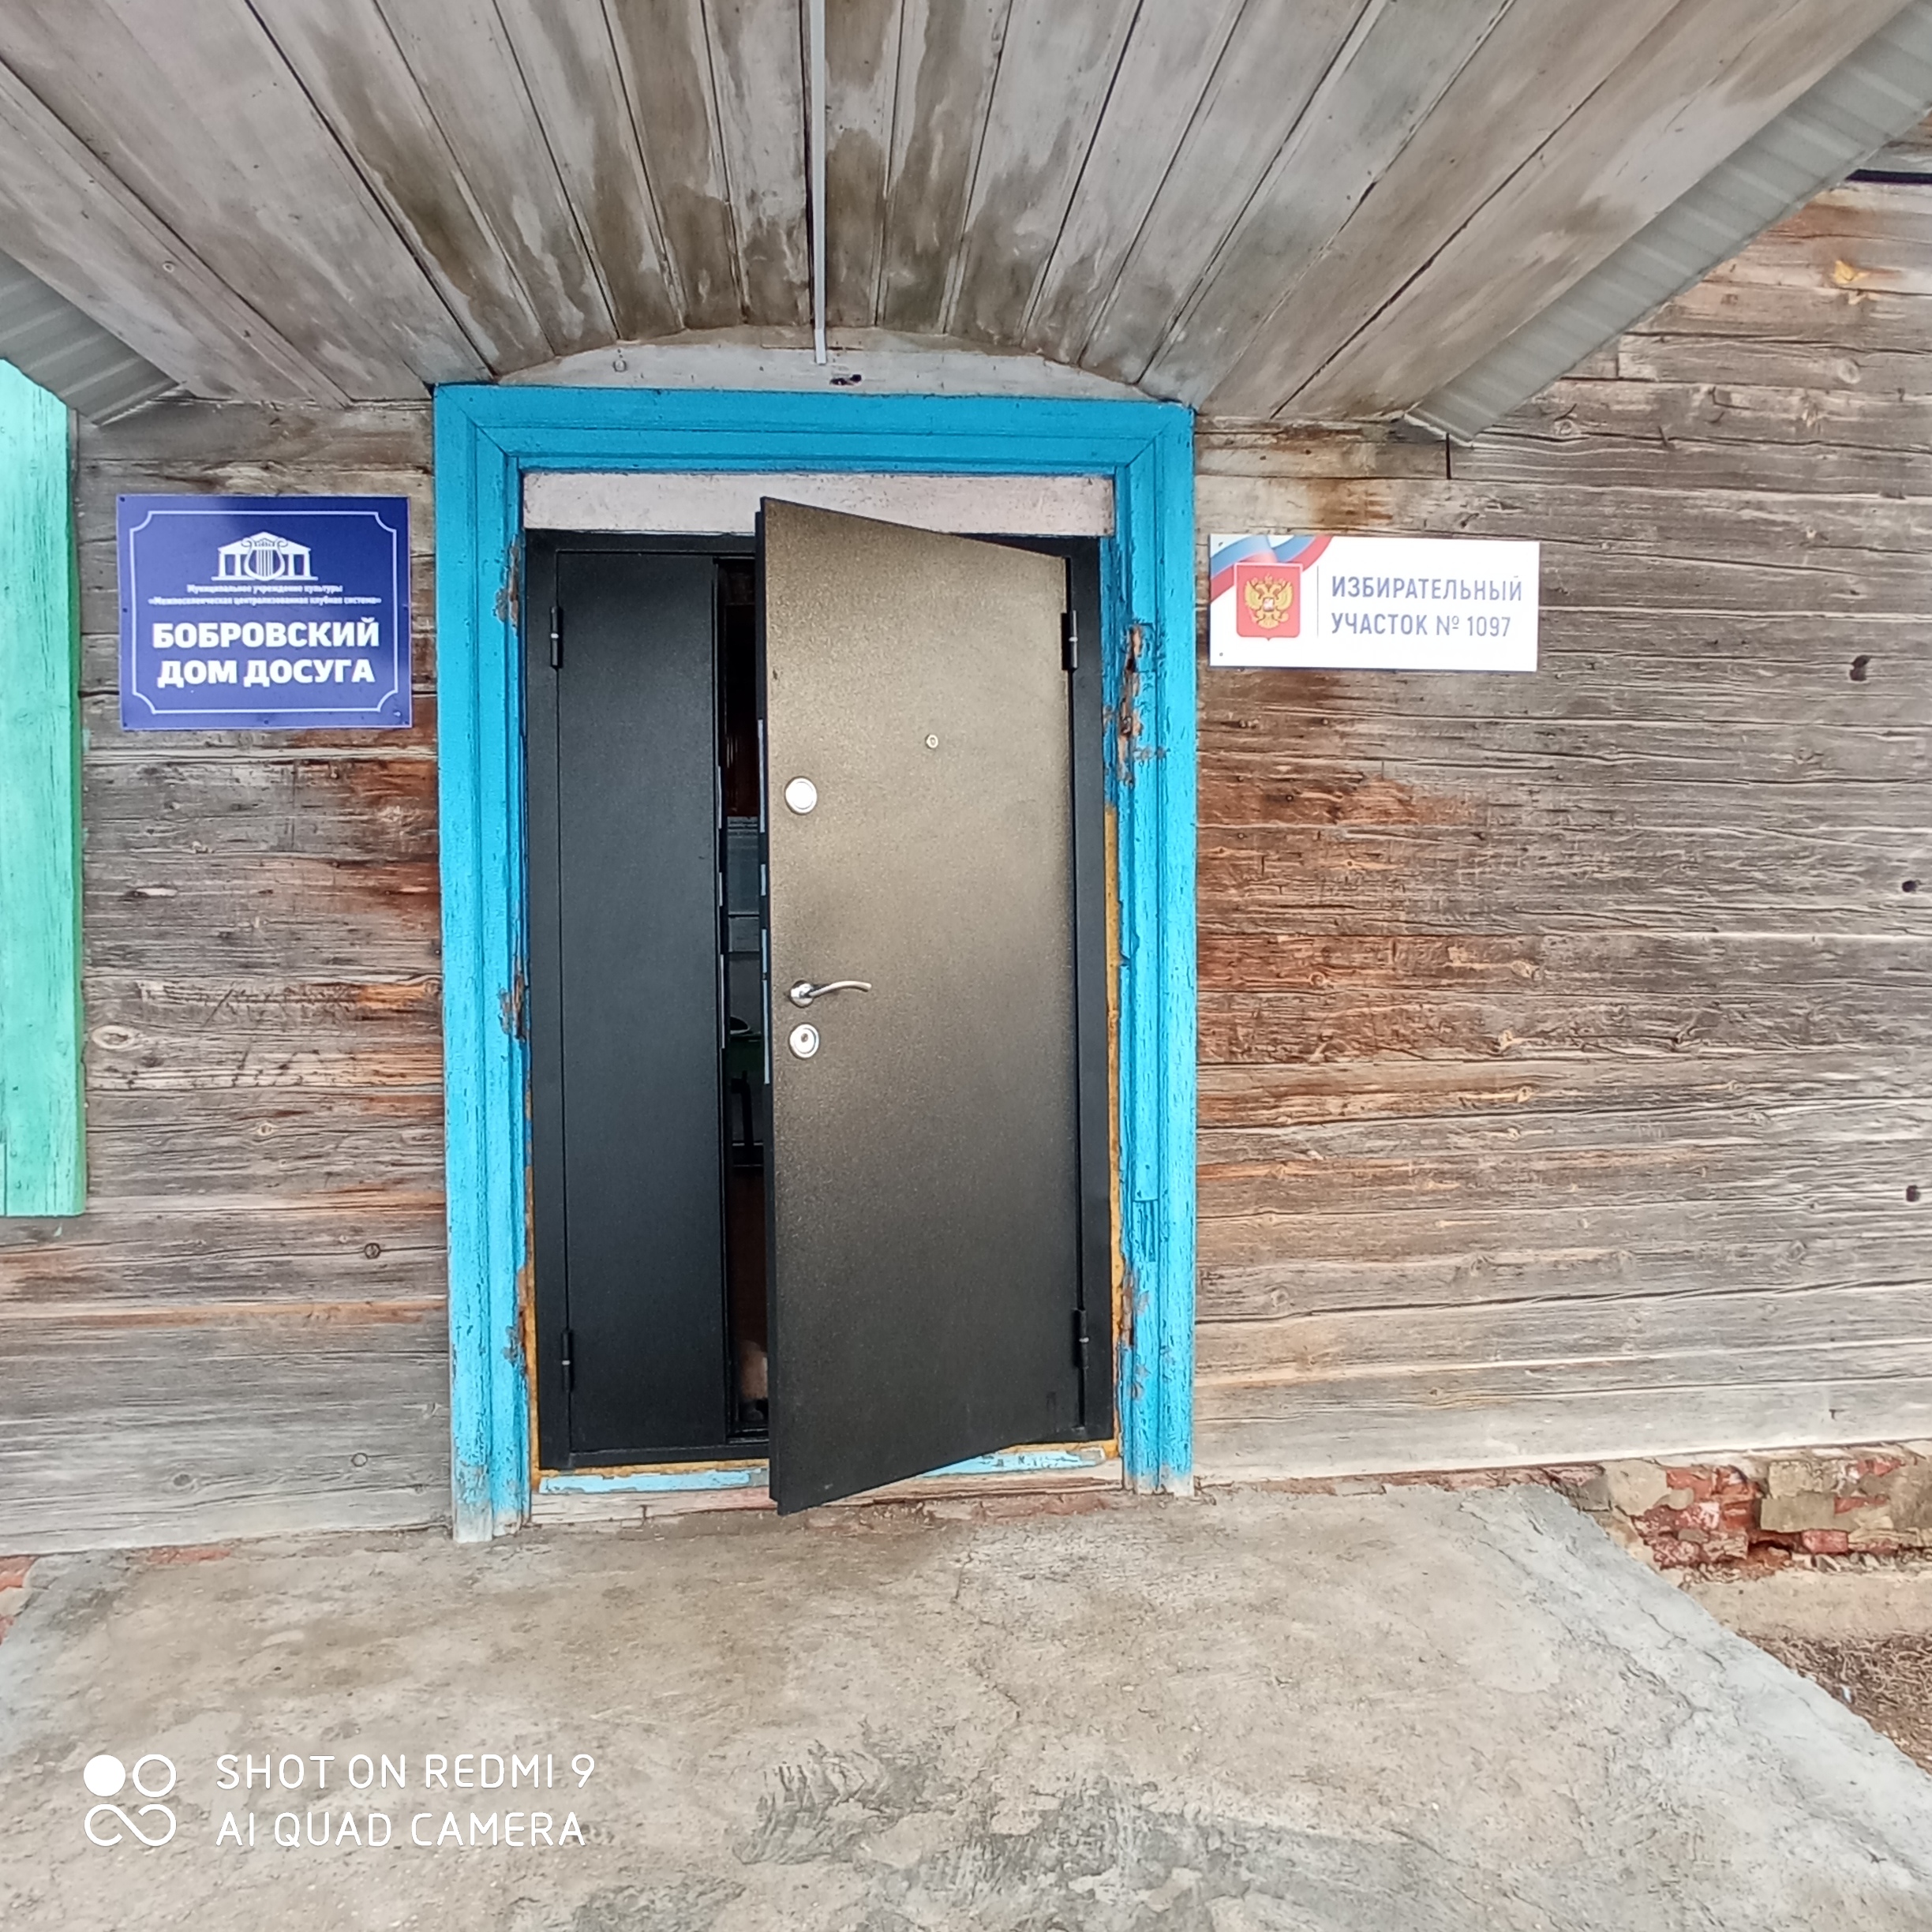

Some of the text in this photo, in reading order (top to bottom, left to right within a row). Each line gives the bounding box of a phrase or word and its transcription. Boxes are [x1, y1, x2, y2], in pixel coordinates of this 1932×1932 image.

[1331, 575, 1522, 601] ИЗБИРАТЕЛЬНЫЙ
[152, 616, 380, 648] БОБРОВСКИЙ
[1331, 612, 1428, 636] УЧАСТОК
[1467, 616, 1511, 637] 1097
[157, 659, 376, 688] ДОМ ДОСУГА
